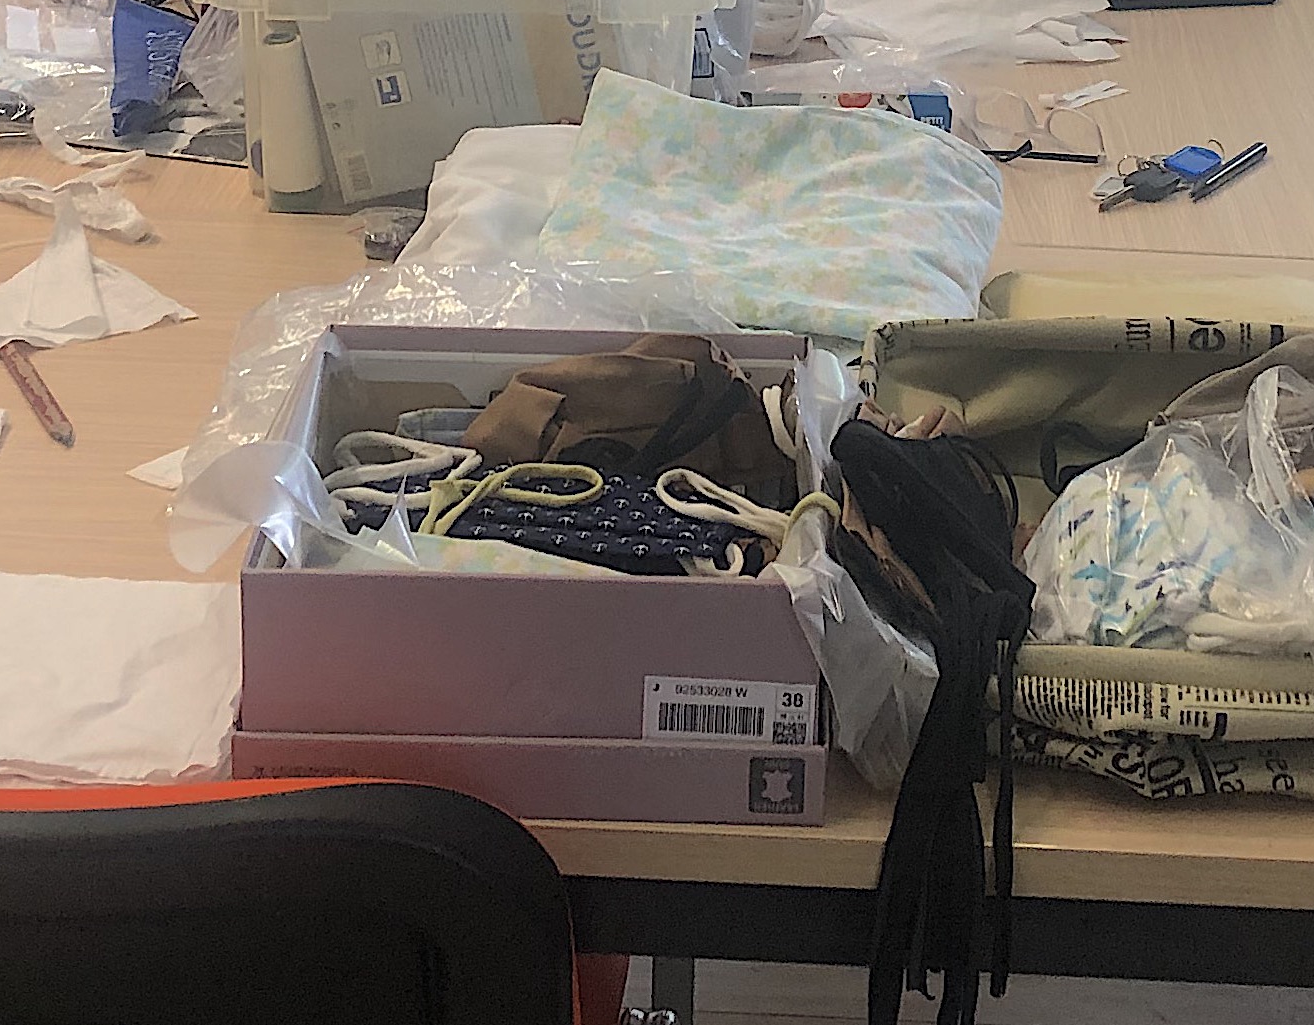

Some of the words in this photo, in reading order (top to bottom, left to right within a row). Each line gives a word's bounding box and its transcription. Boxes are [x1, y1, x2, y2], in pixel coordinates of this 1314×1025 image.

[652, 684, 661, 692] J
[735, 687, 749, 698] W
[781, 692, 804, 708] 38
